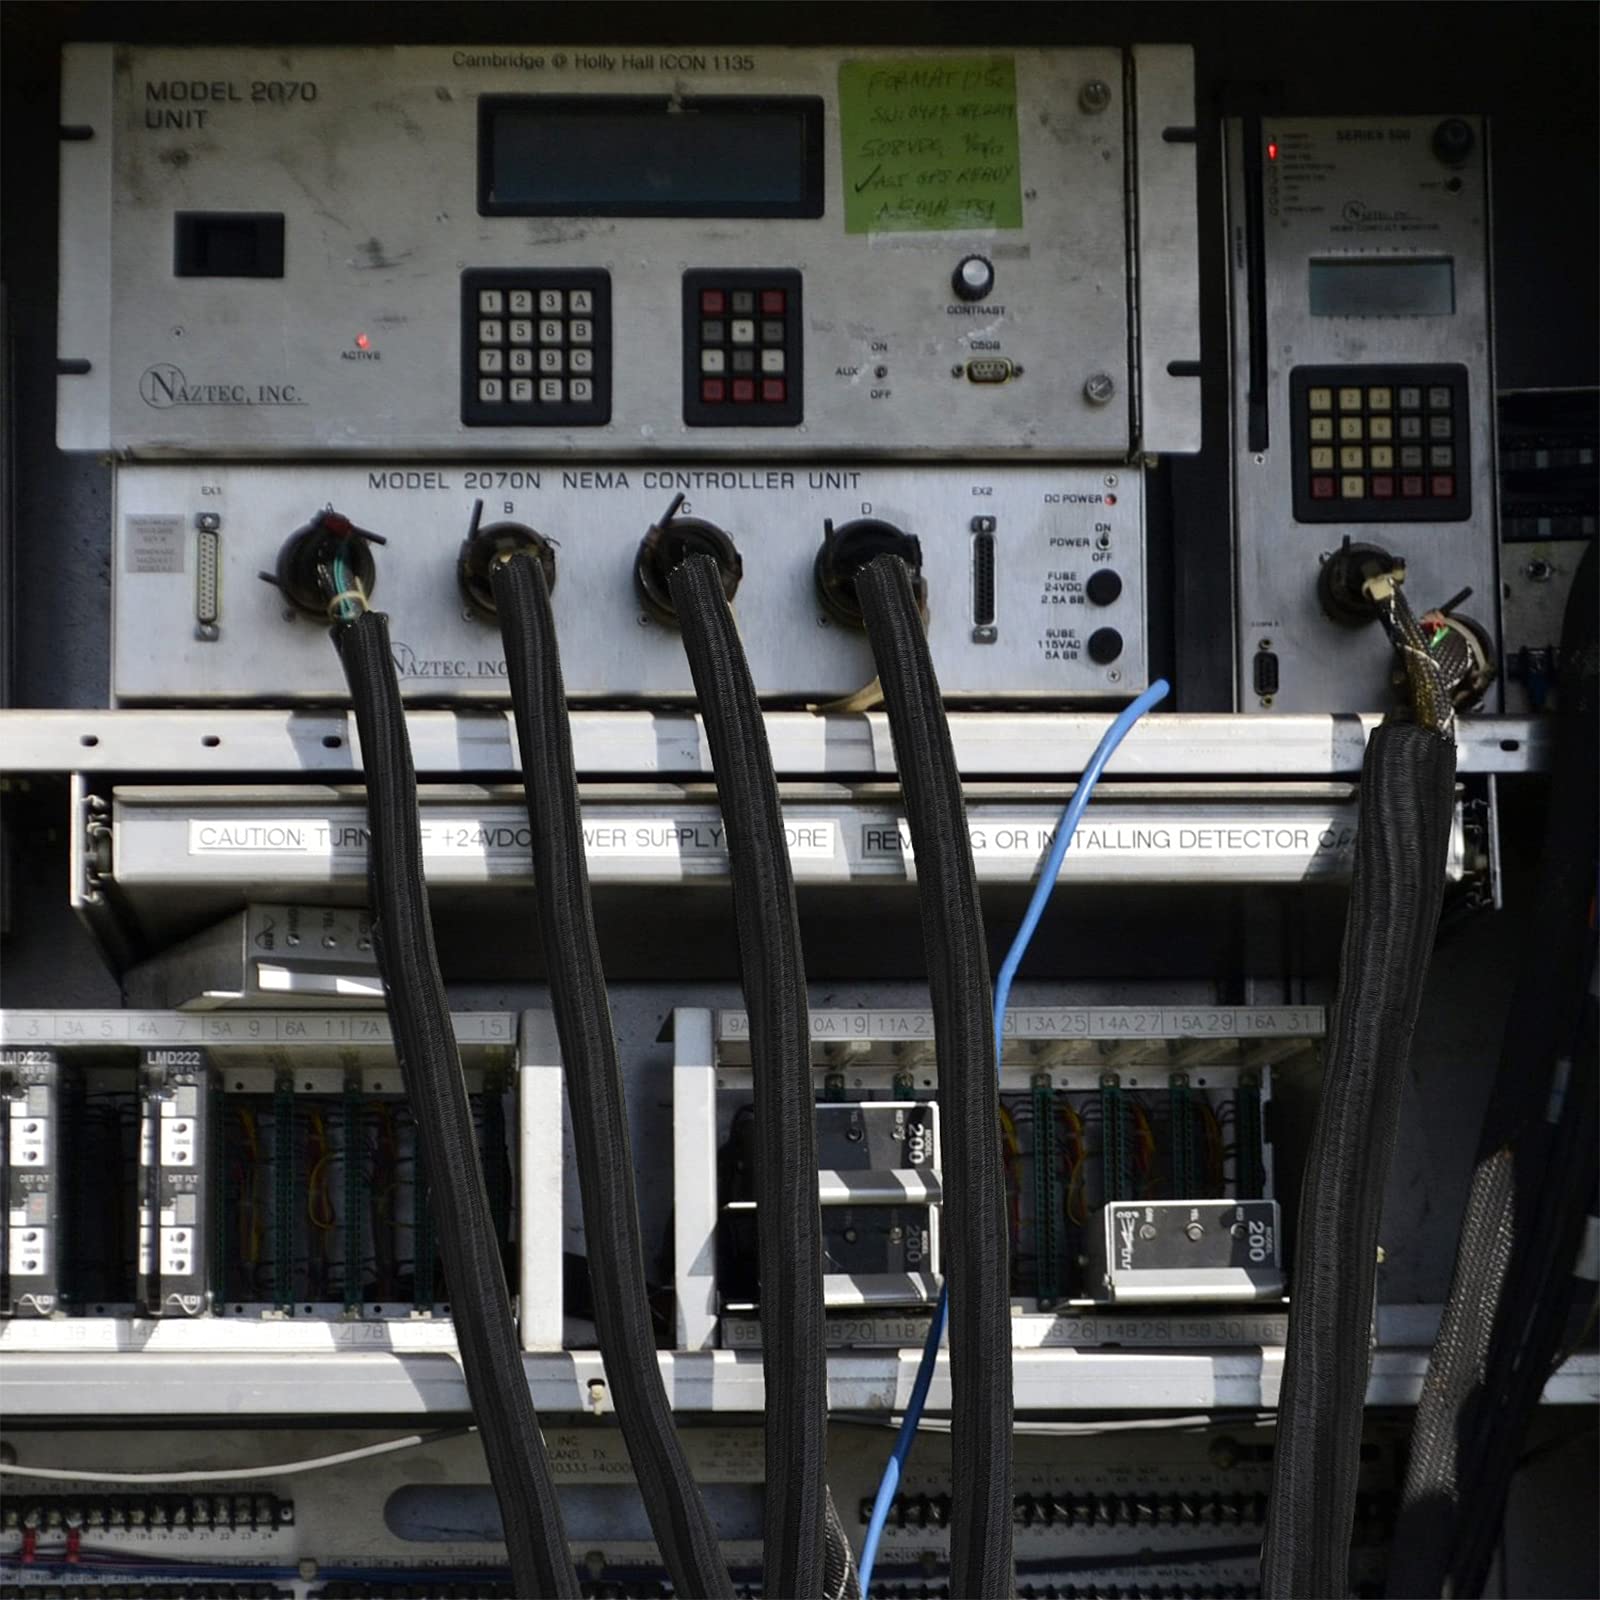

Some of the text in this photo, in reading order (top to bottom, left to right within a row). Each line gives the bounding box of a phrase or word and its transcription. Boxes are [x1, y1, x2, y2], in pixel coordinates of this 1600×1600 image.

[452, 52, 755, 73] Cambridge @ Holly Hall ICON 1135
[146, 81, 318, 102] MODEL 2070
[146, 109, 208, 130] UNIT
[1336, 129, 1384, 141] SERIES
[486, 294, 587, 308] 1 2 3 A
[946, 305, 1006, 315] CONTRAST
[486, 324, 587, 338] 4 5 6 B
[871, 342, 888, 352] ON
[340, 351, 381, 361] ACTIVE
[486, 353, 587, 367] 7 8 9 C
[836, 367, 857, 377] AUX
[258, 384, 302, 404] INC.
[486, 382, 587, 396] 0 F E D
[870, 389, 891, 399] OFF
[369, 472, 861, 490] MODEL 2070N NEMA CONTROLLER UNIT
[972, 486, 993, 496] EX2
[1044, 494, 1103, 504] DC POWER
[504, 502, 514, 514] B
[682, 502, 692, 514] C
[862, 503, 872, 515] D
[1095, 523, 1112, 533] ON
[1049, 537, 1090, 548] POWER
[1092, 553, 1112, 563] OFF
[1047, 572, 1077, 582] FUSE
[1044, 582, 1083, 593] 24VDC
[1038, 640, 1081, 650] 115VAC
[199, 828, 305, 847] CAUTION:
[315, 828, 371, 847] TURN
[442, 828, 532, 847] +24VDC
[635, 829, 723, 847] SUPPLY
[995, 830, 1029, 848] OR
[1038, 830, 1171, 849] INTALLING
[1180, 830, 1309, 849] DETECTOR
[28, 1019, 40, 1036] 3
[64, 1020, 85, 1036] 3A
[101, 1020, 113, 1036] 5
[137, 1020, 158, 1035] 4A
[176, 1019, 188, 1036] 7
[211, 1020, 232, 1036] 5A
[249, 1020, 261, 1037] 9
[285, 1021, 306, 1037] 6A
[326, 1020, 346, 1036] 11
[360, 1021, 380, 1036] 7A
[479, 1019, 503, 1036] 15
[814, 1017, 836, 1033] 0A
[843, 1017, 866, 1034] 19
[880, 1017, 908, 1033] 11A
[1025, 1014, 1055, 1033] 13A
[1061, 1014, 1087, 1033] 25
[1098, 1014, 1129, 1033] 14A
[1134, 1014, 1160, 1033] 27
[1172, 1014, 1203, 1033] 15A
[1206, 1014, 1233, 1033] 29
[1245, 1014, 1276, 1033] 16A
[1288, 1014, 1311, 1033] 31
[147, 1052, 201, 1065] LMD222
[908, 1123, 934, 1165] MODEL 200
[905, 1224, 922, 1264] 200
[1248, 1220, 1266, 1262] 200
[365, 1324, 384, 1338] 7B
[734, 1325, 757, 1340] 9B
[844, 1323, 872, 1339] 20
[884, 1324, 915, 1339] 11B
[1067, 1322, 1096, 1340] 26
[1106, 1323, 1136, 1339] 14B
[1141, 1322, 1168, 1340] 28
[1179, 1323, 1210, 1339] 15B
[1215, 1322, 1242, 1340] 30
[1254, 1323, 1287, 1339] 16B
[592, 1449, 607, 1460] TX
